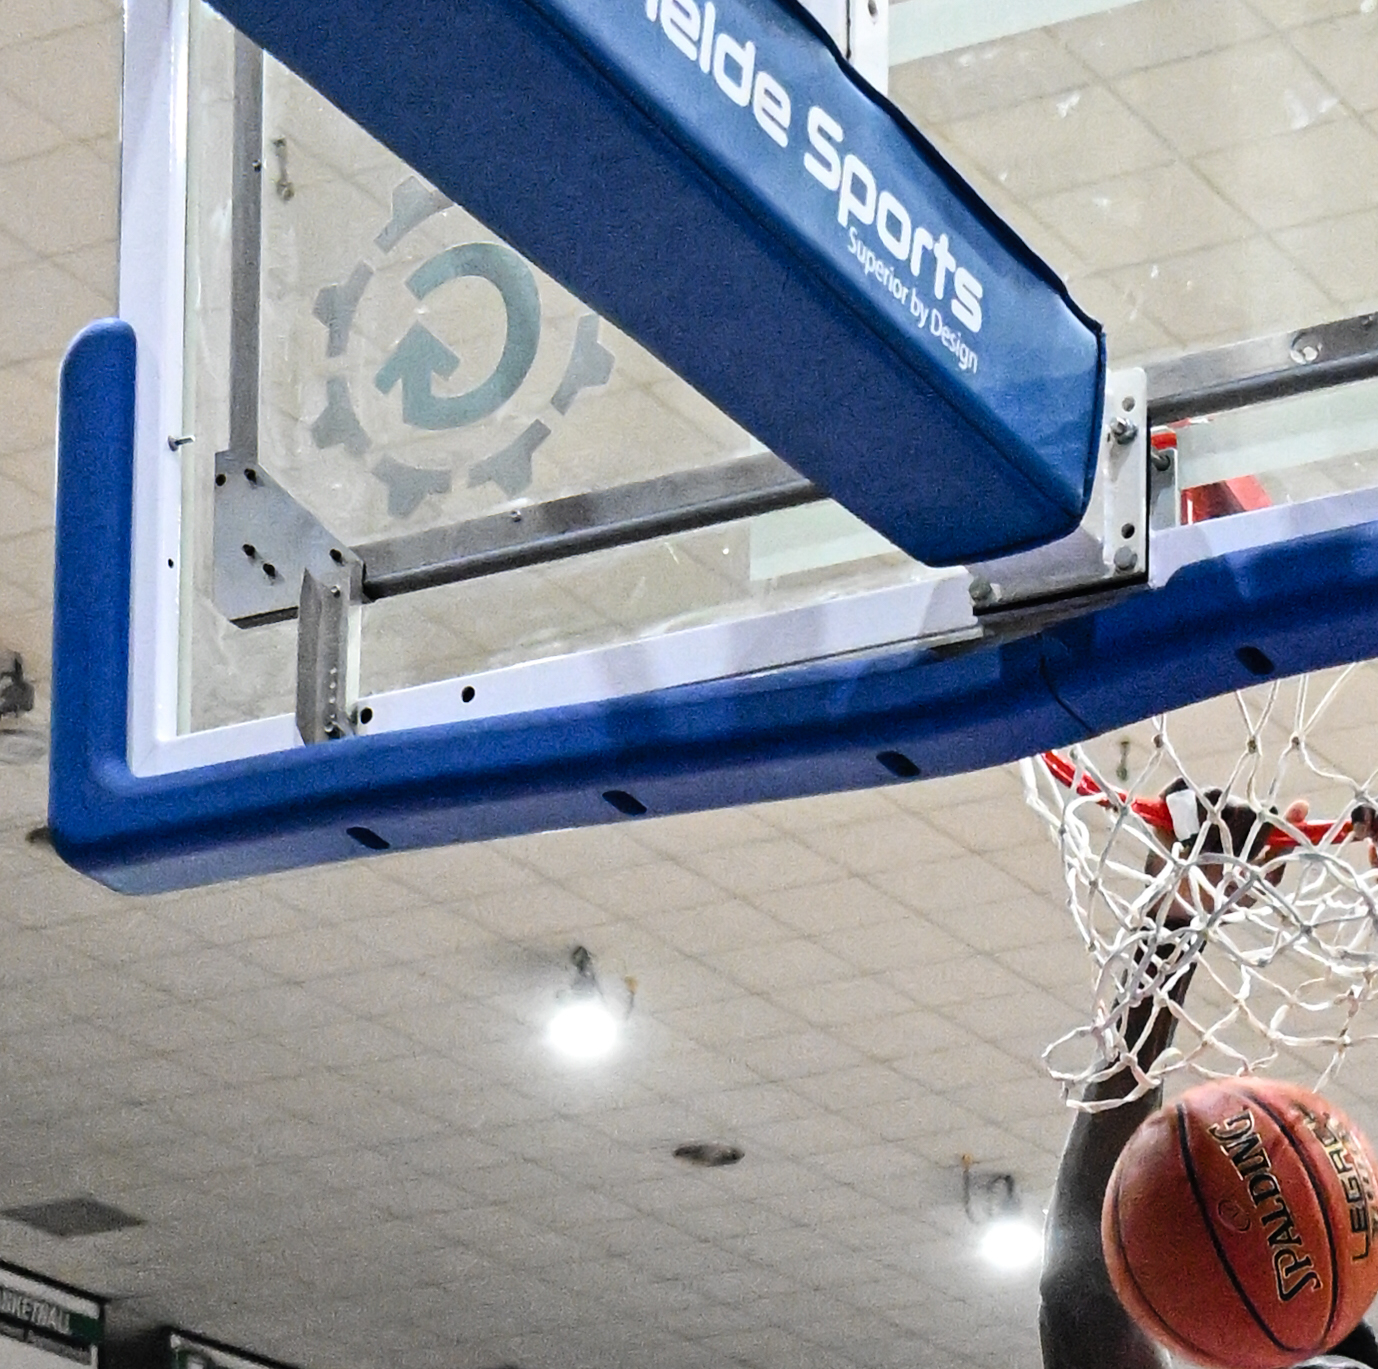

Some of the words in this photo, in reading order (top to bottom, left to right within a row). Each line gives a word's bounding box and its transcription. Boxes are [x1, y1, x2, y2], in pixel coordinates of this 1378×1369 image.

[646, 0, 792, 148] elde
[803, 106, 983, 333] Sports
[847, 226, 910, 306] Superior
[910, 289, 929, 328] by
[930, 310, 979, 375] Design
[1208, 1108, 1323, 1303] SPALDING
